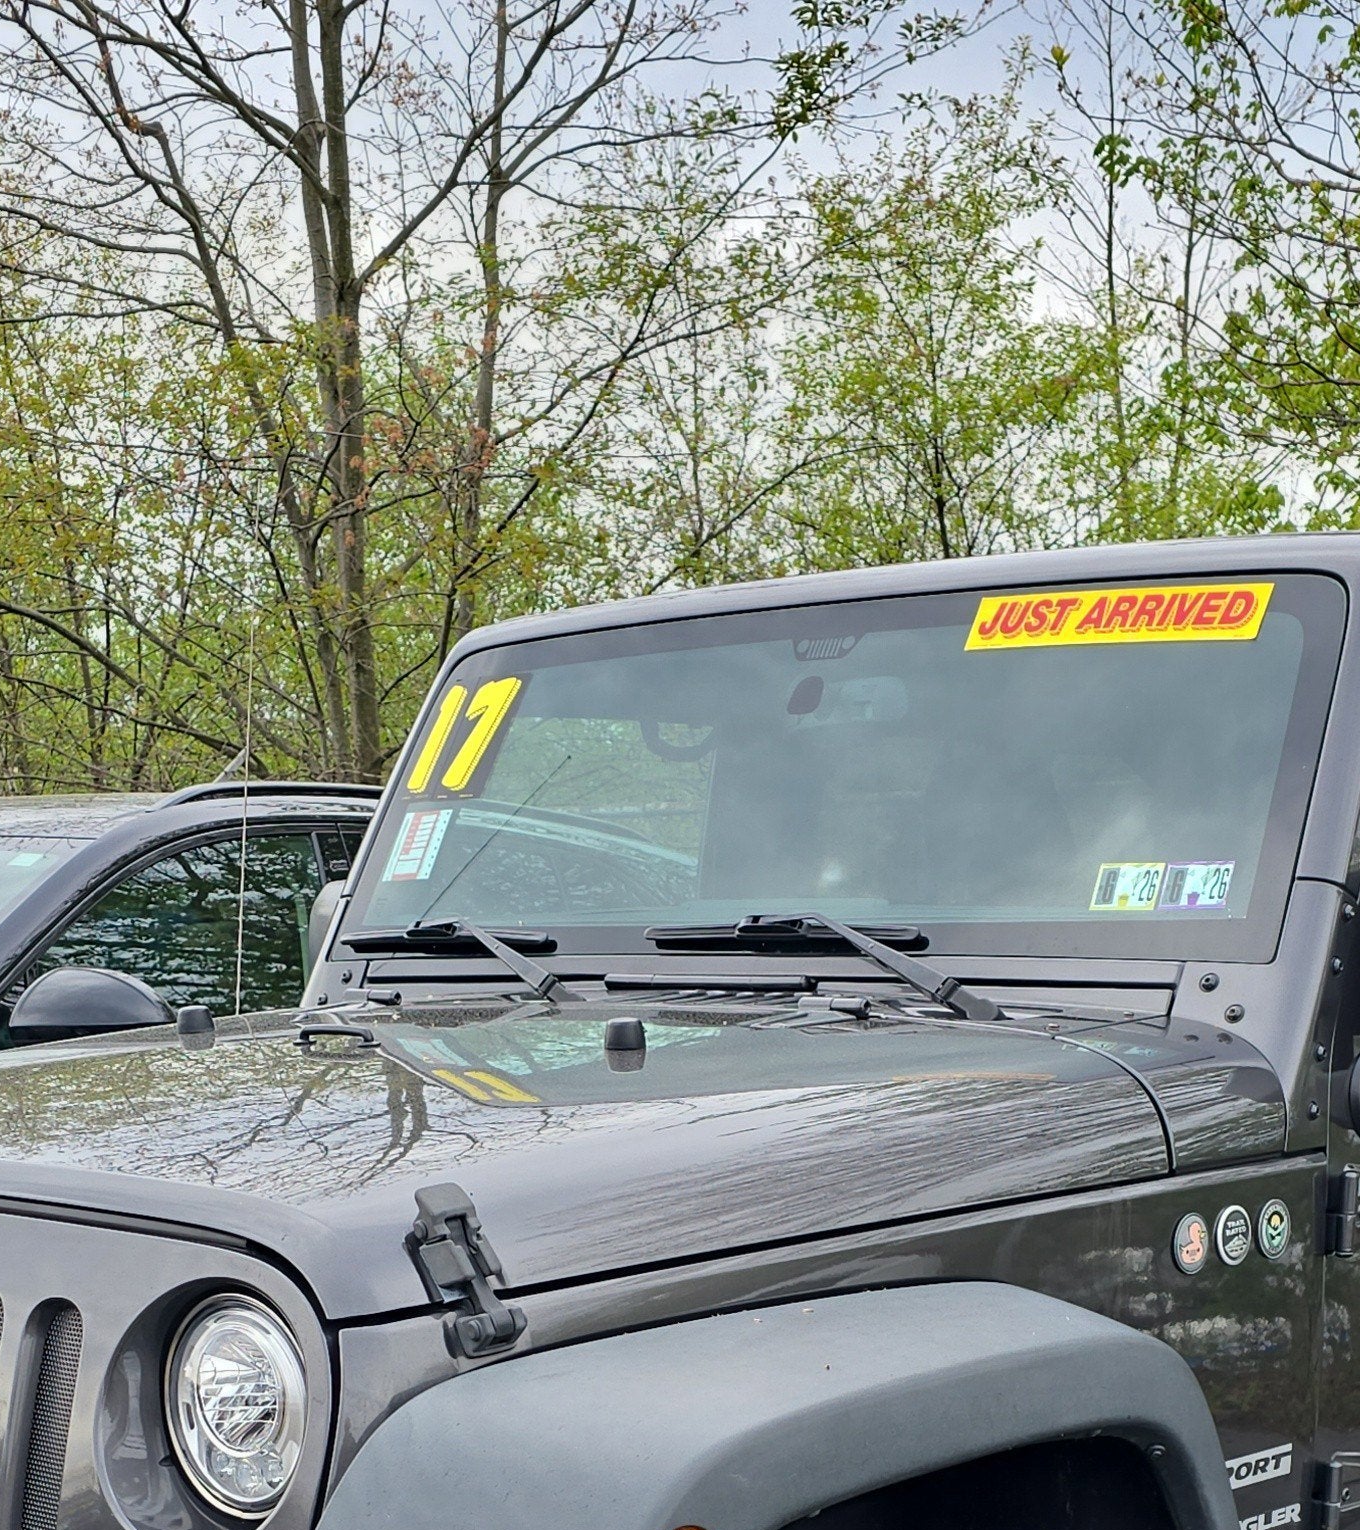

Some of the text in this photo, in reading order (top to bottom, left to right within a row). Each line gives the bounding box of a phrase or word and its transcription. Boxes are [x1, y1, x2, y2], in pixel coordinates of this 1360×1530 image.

[978, 590, 1258, 639] JUST ARRIVED
[406, 676, 523, 794] 17
[1138, 869, 1159, 902] 26
[1208, 867, 1231, 900] 26
